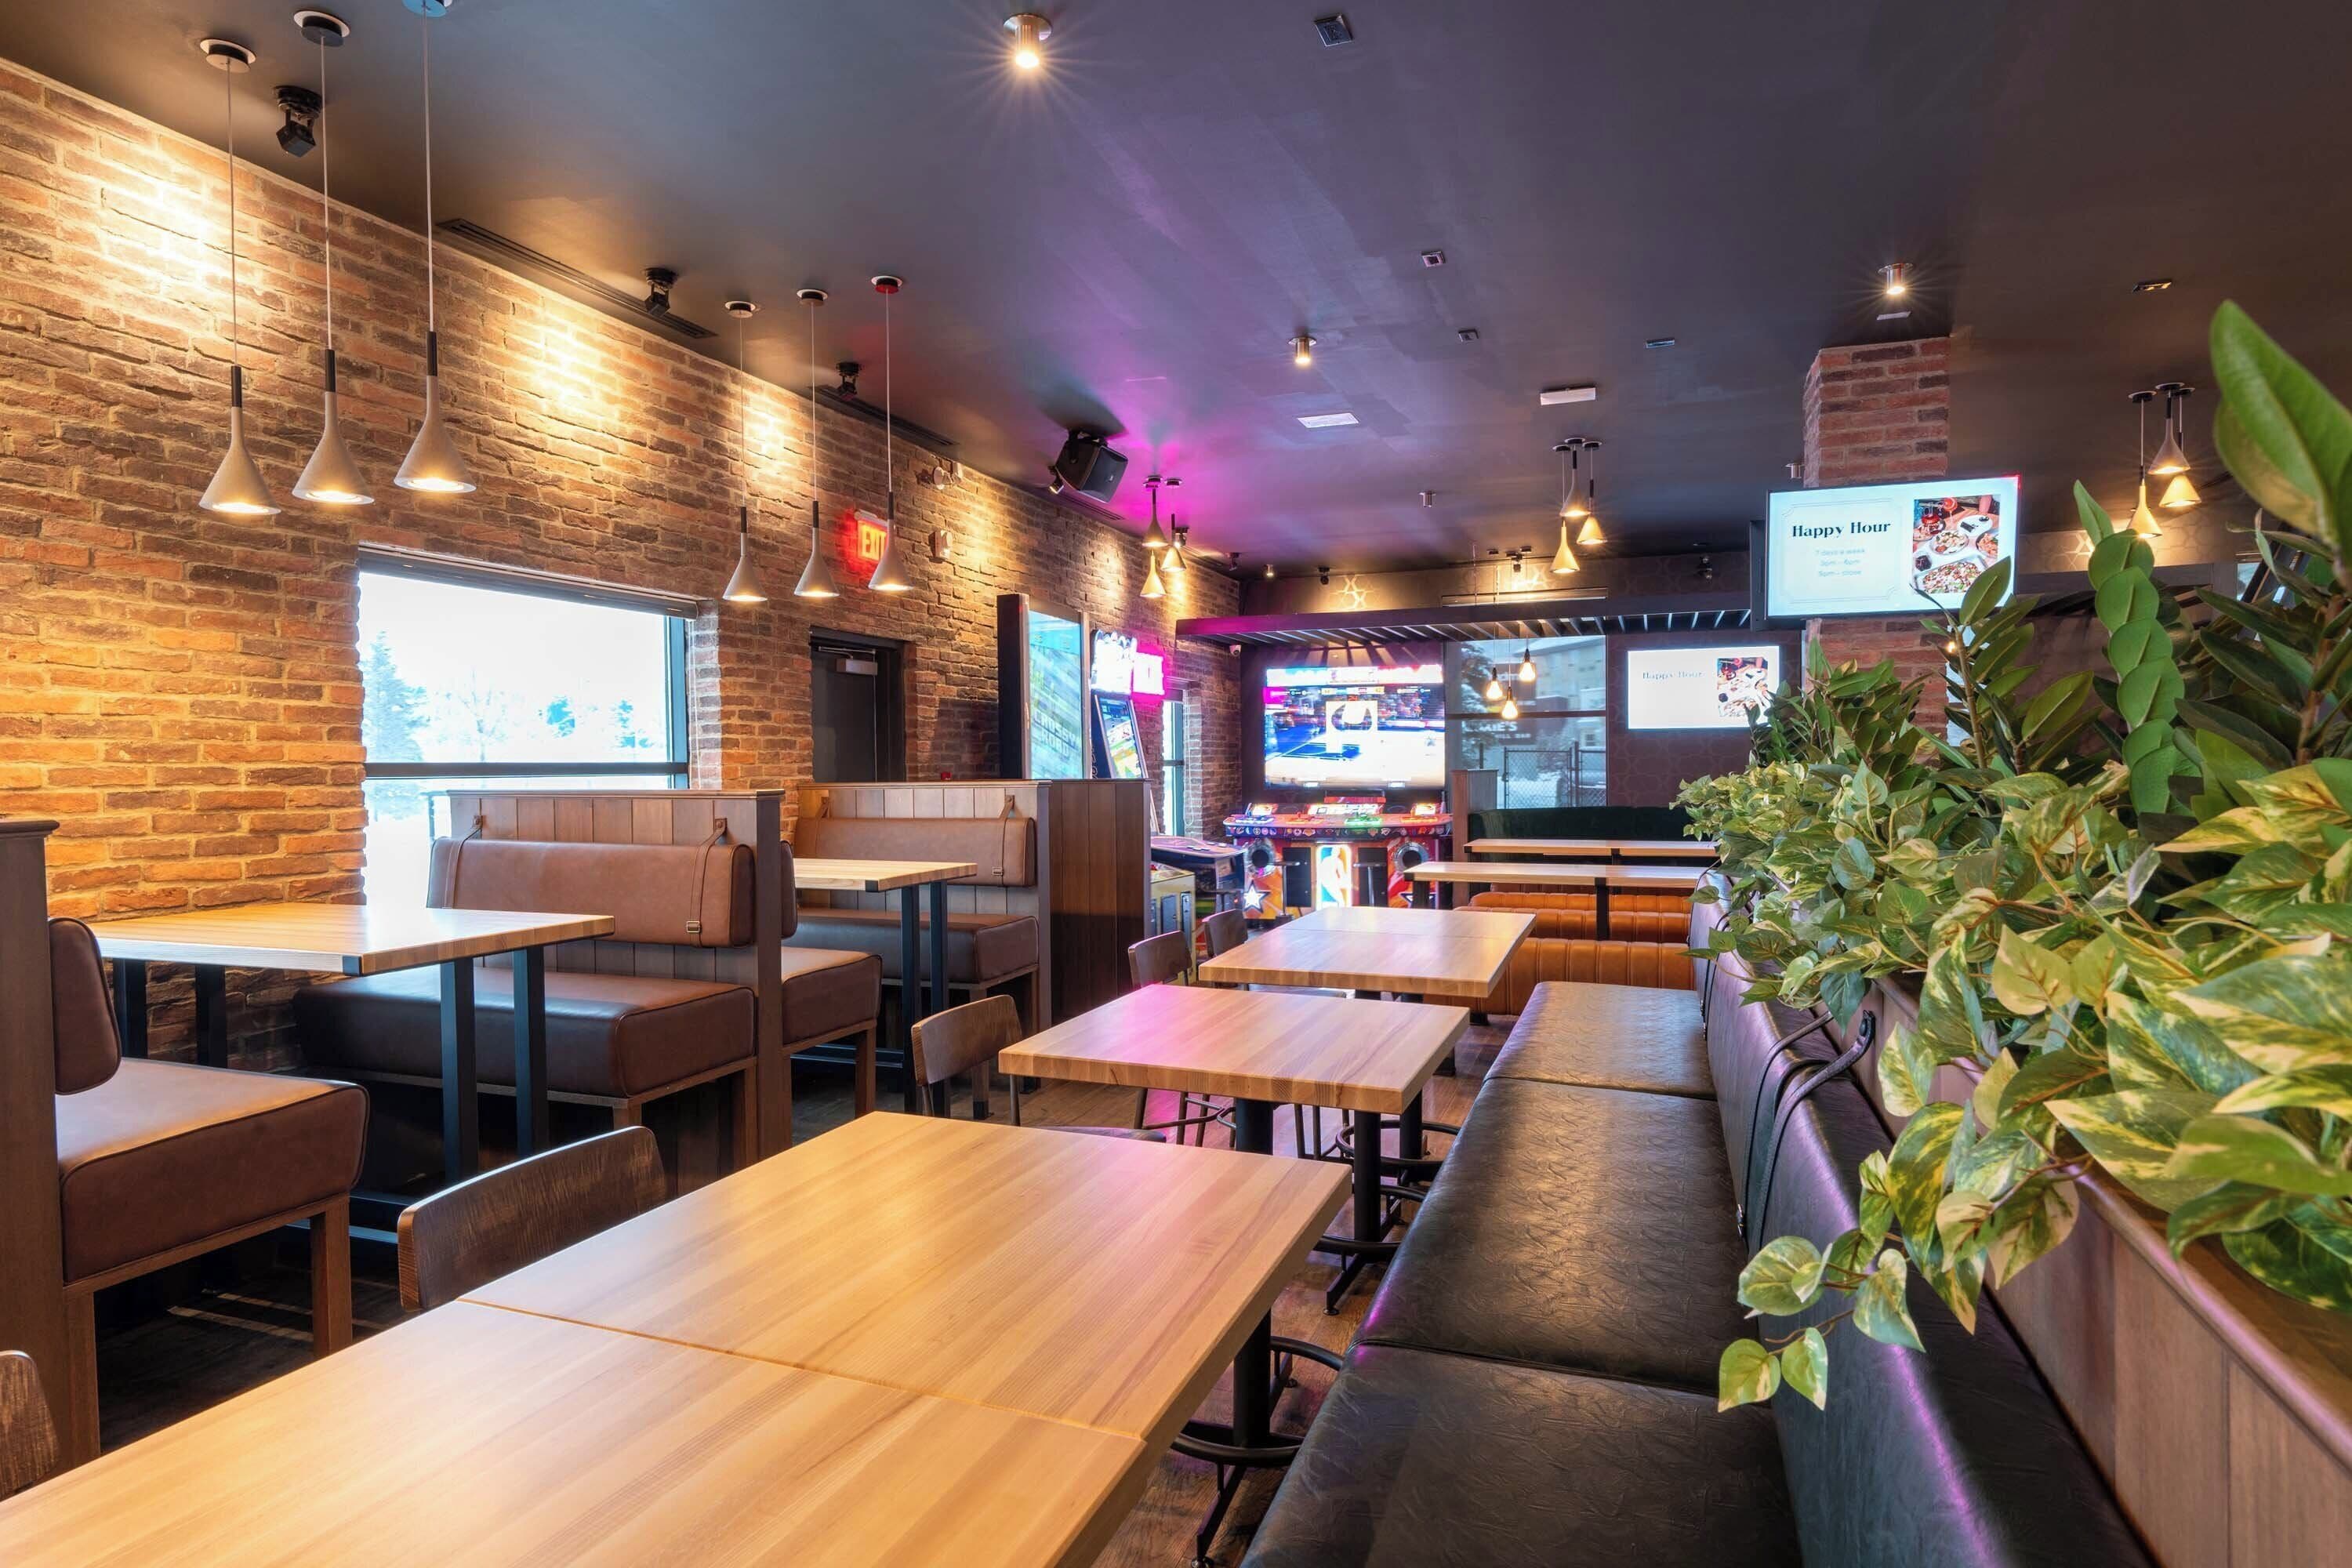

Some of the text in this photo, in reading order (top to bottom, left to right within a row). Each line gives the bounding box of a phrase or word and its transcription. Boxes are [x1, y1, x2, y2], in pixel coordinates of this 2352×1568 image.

[862, 526, 887, 560] EXI
[1792, 521, 1891, 539] Happy Hour
